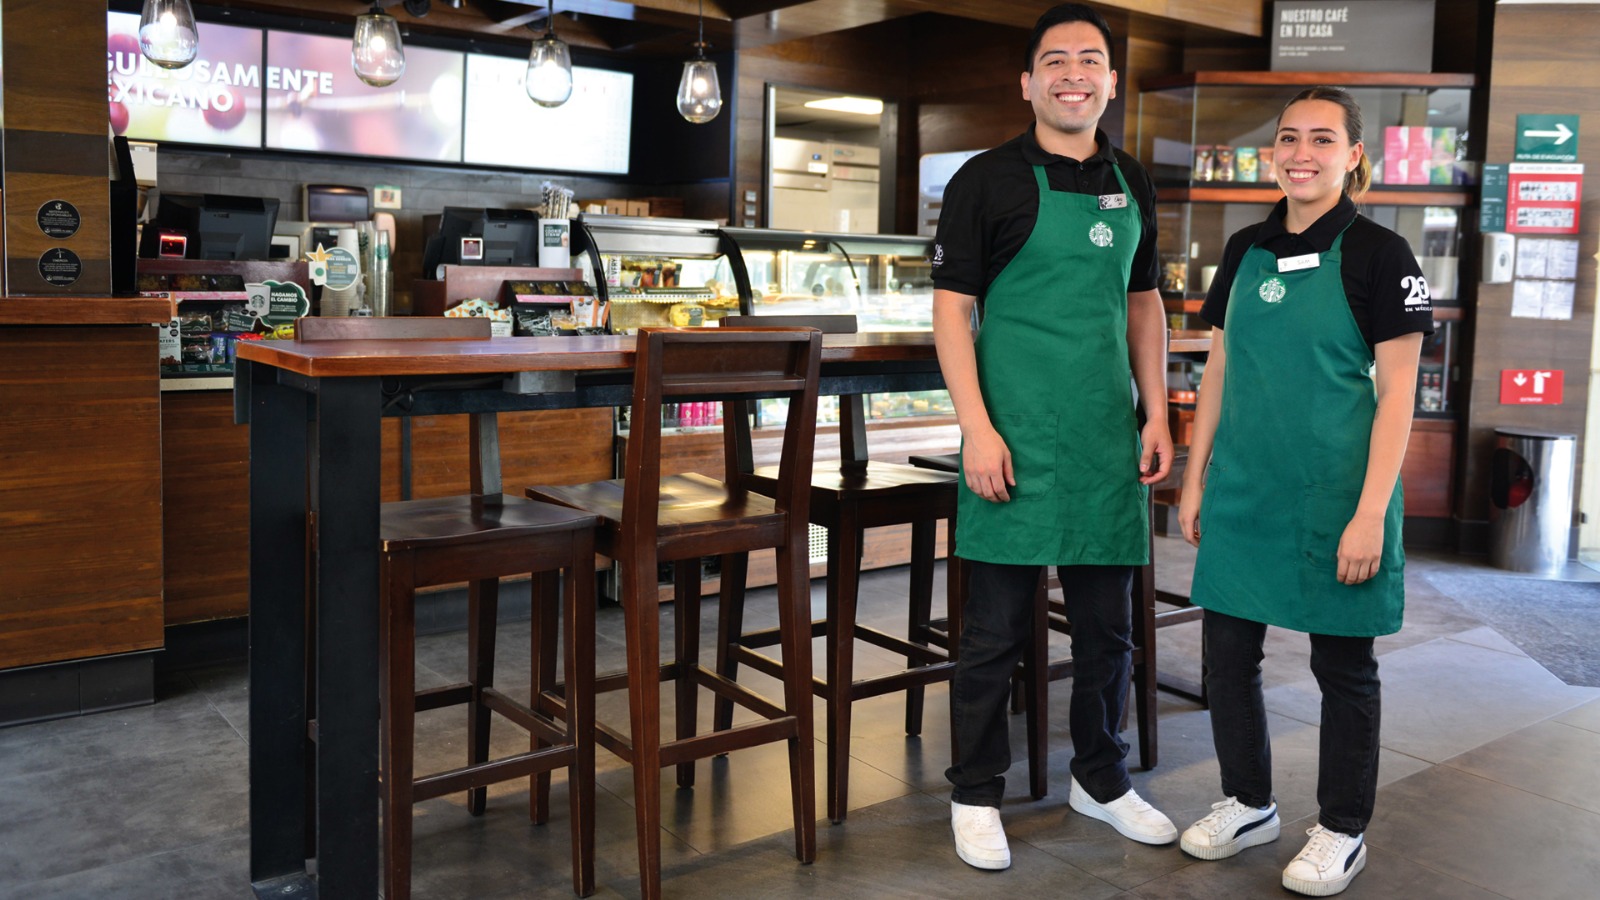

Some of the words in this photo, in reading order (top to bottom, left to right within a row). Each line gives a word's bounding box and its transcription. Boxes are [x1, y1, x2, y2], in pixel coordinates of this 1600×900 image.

[1281, 9, 1323, 22] NUESTRO
[1325, 6, 1348, 22] CAFÉ
[1280, 24, 1293, 38] EN
[1295, 24, 1307, 38] TU
[1309, 24, 1333, 37] CASA
[1401, 276, 1430, 305] 20
